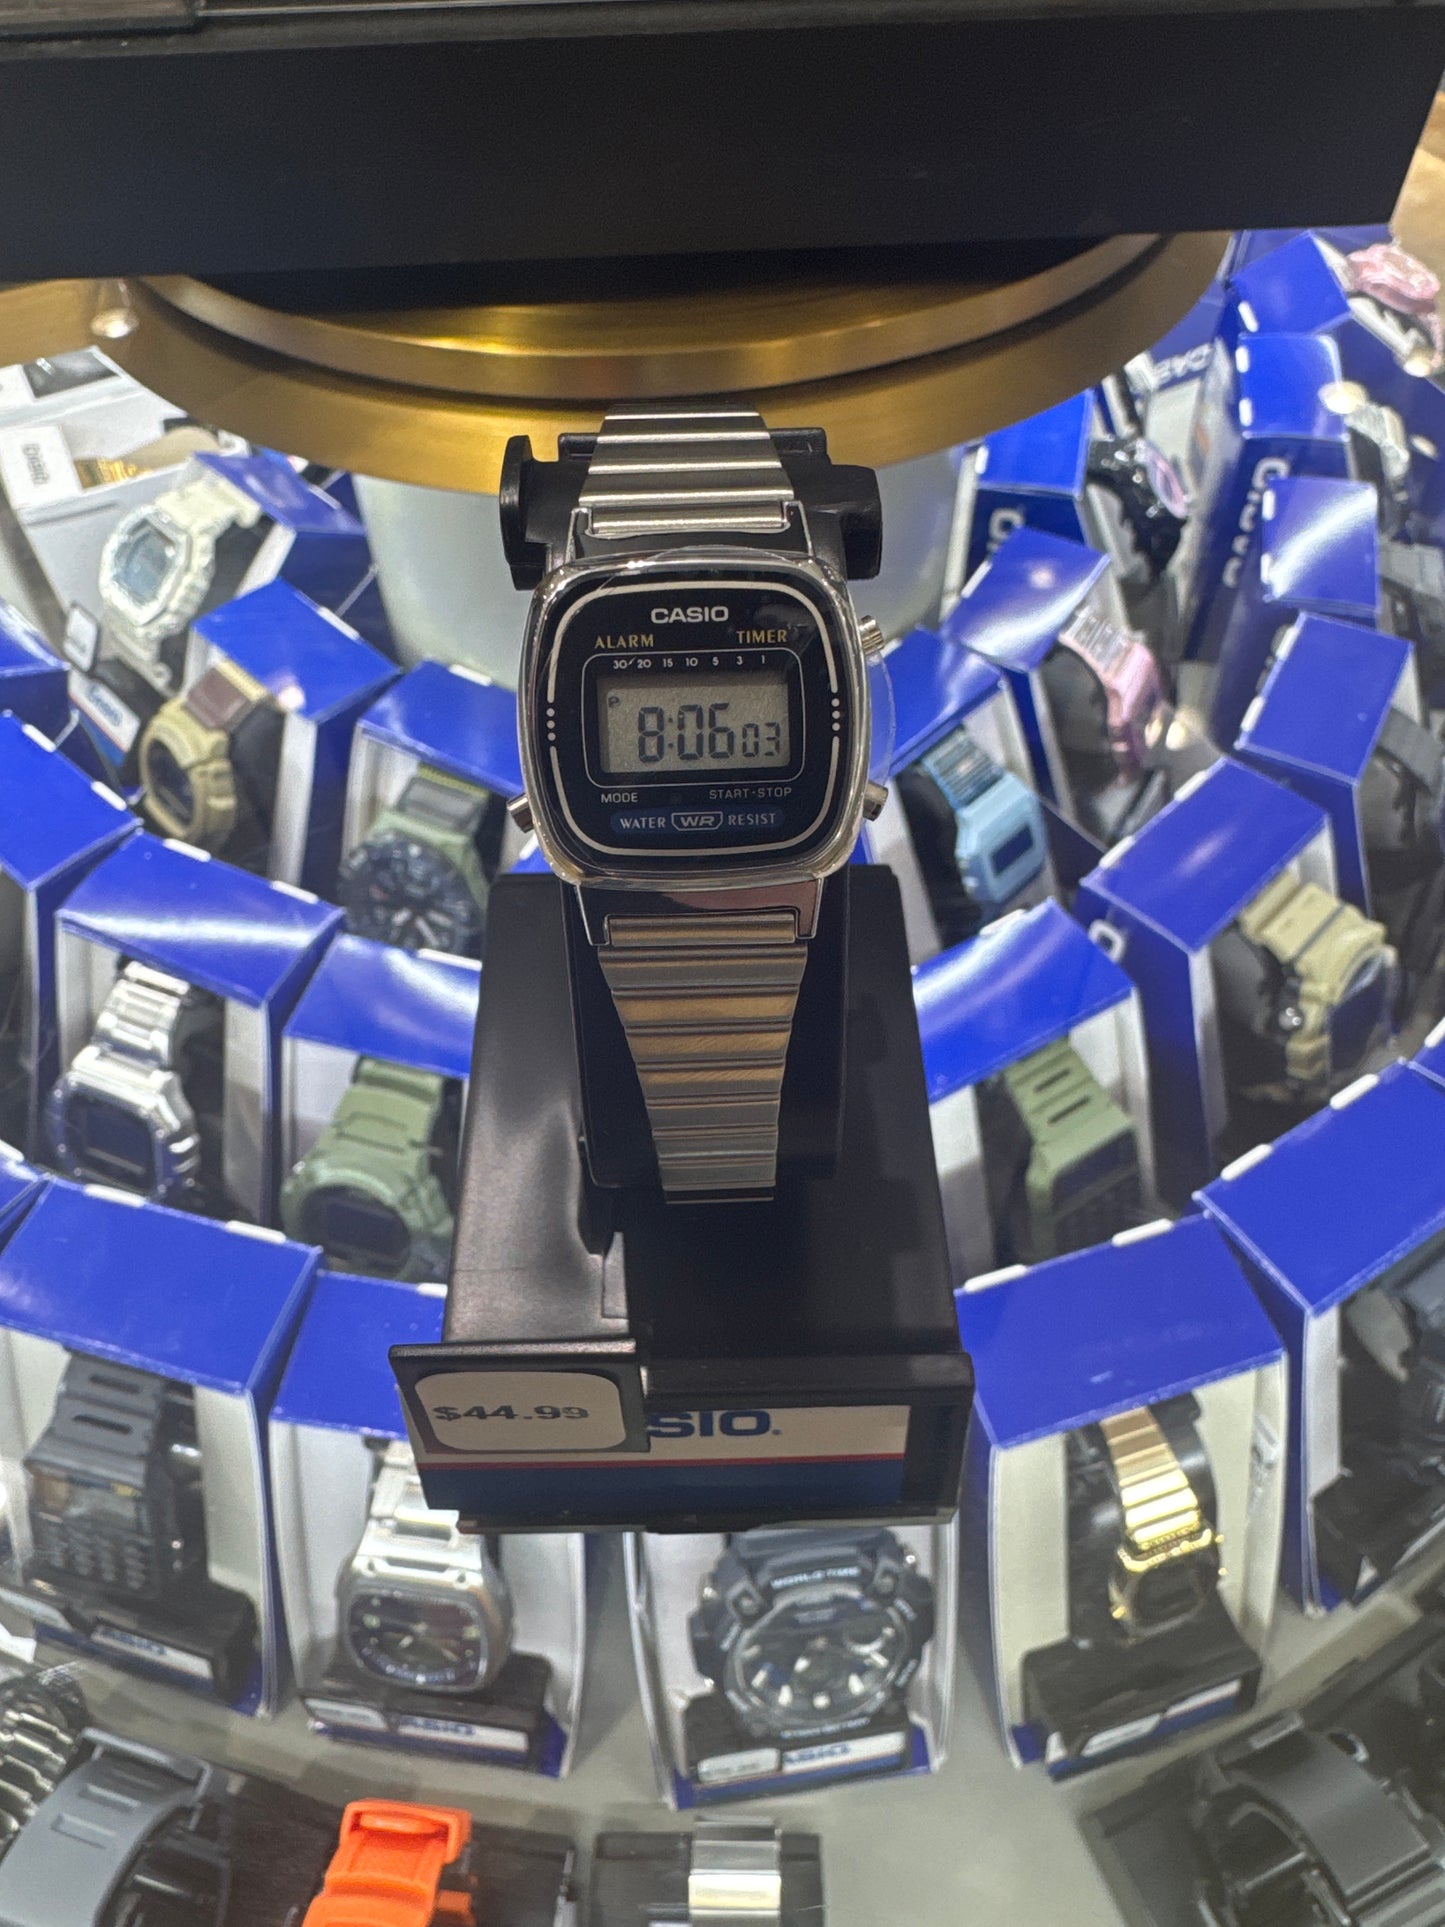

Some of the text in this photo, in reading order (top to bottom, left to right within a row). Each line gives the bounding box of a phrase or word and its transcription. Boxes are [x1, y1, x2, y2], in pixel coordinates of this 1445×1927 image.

[650, 605, 730, 624] CASIO
[594, 633, 655, 648] ALARM
[736, 629, 788, 645] TIMER
[613, 655, 766, 669] 30 20 15 10 5 3 1
[638, 702, 781, 763] 8:06 03
[600, 792, 639, 804] MODE
[619, 812, 776, 830] WATER WR RESIST
[432, 1404, 590, 1422] $44.99
